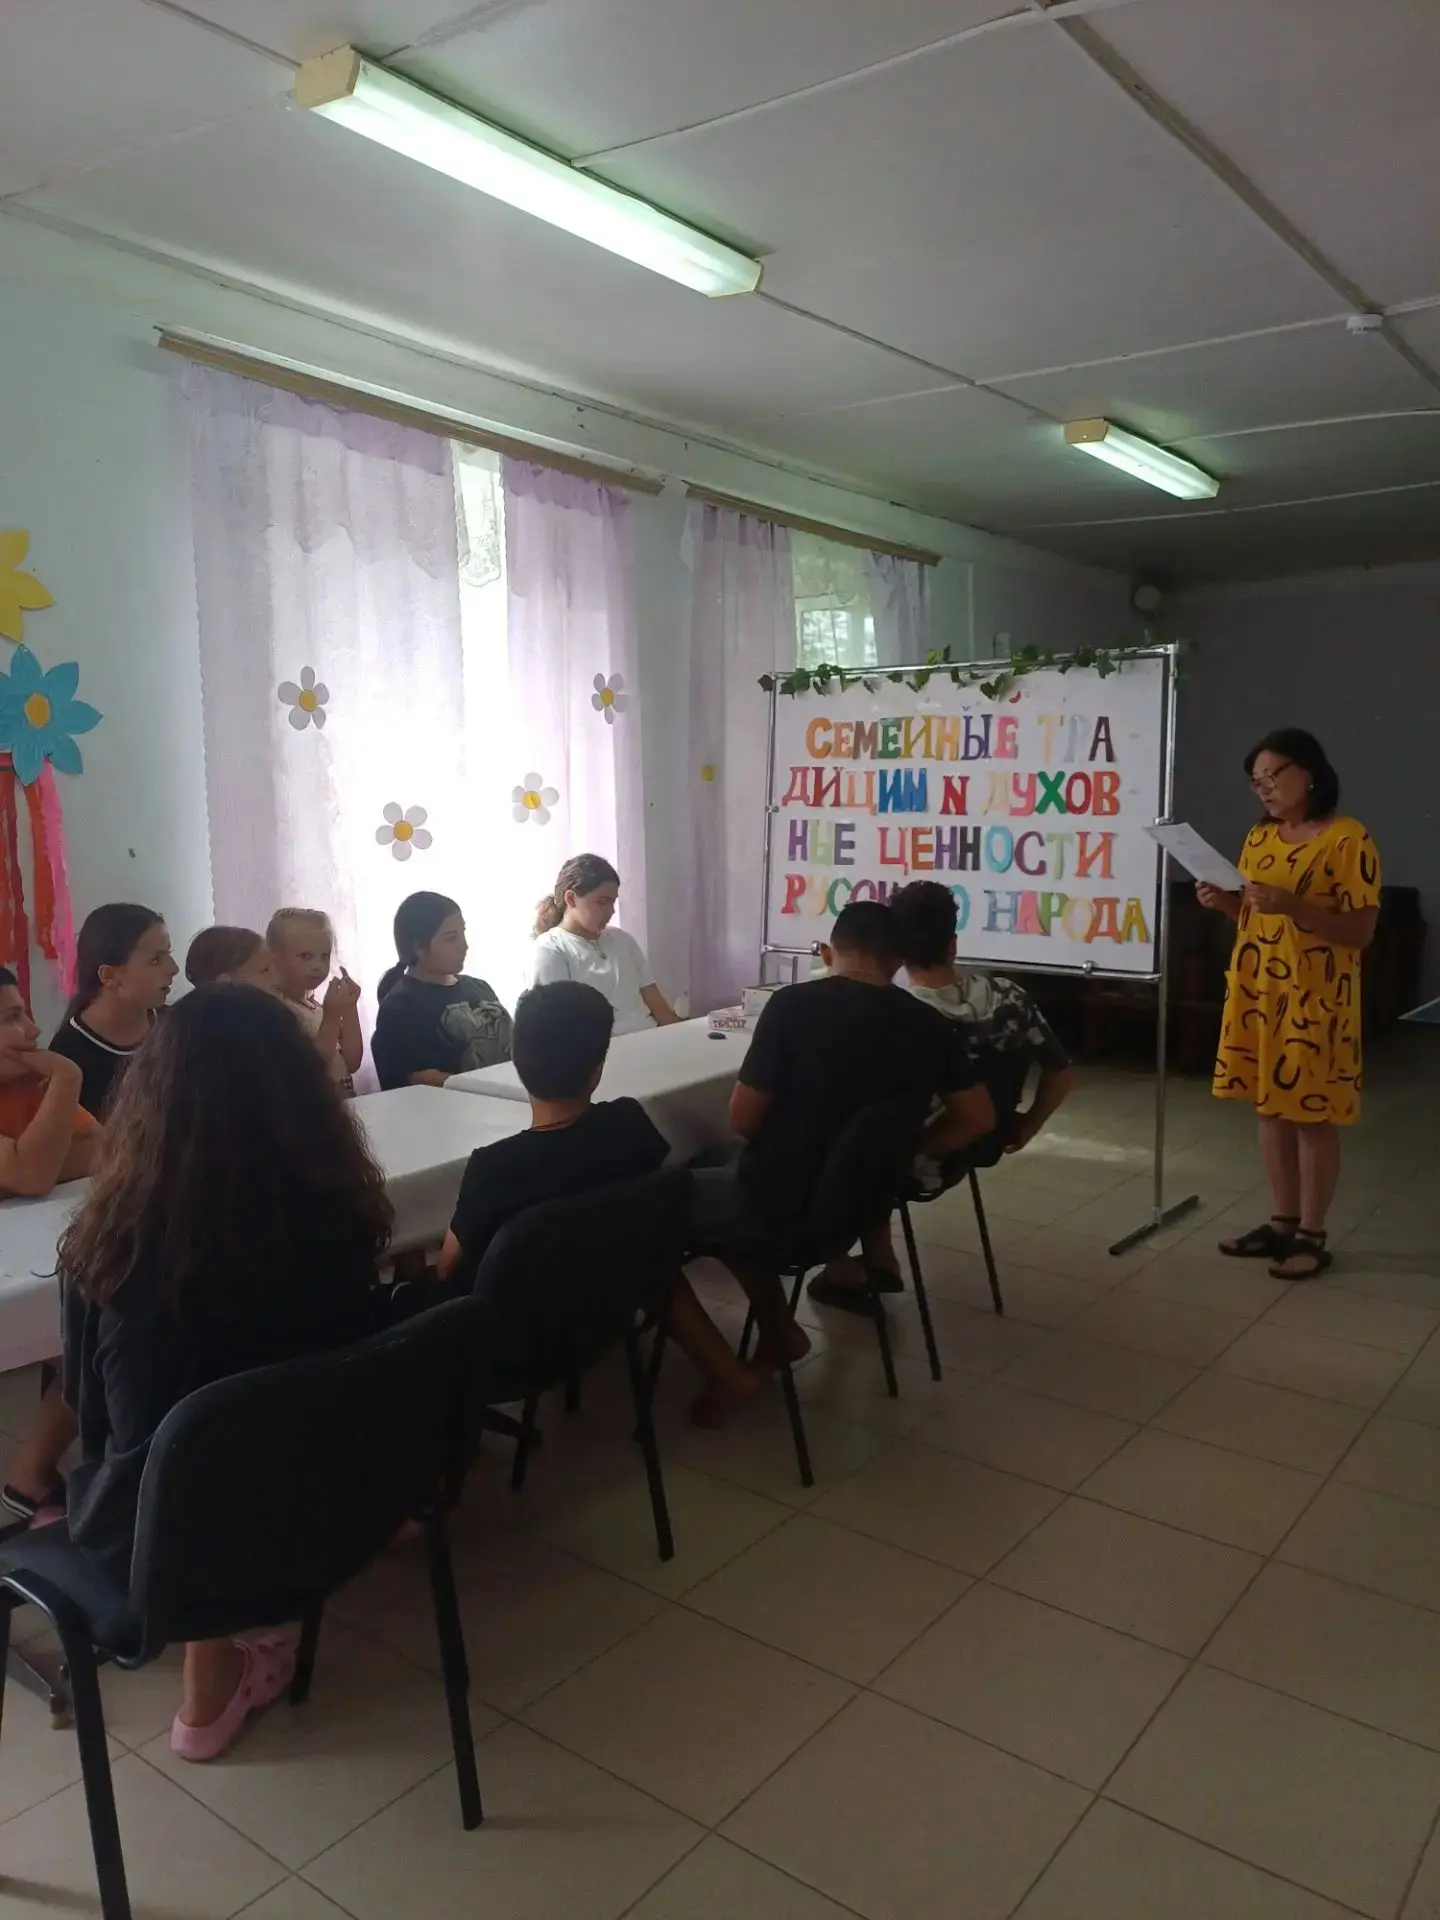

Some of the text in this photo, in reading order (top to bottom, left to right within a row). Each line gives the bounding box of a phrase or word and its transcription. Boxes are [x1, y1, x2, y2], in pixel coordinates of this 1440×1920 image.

[1036, 714, 1116, 763] ТРА
[982, 770, 1120, 816] ДУХОВ
[877, 825, 1117, 880] ЦЕННОСТИ
[983, 889, 1152, 944] НАРОДА
